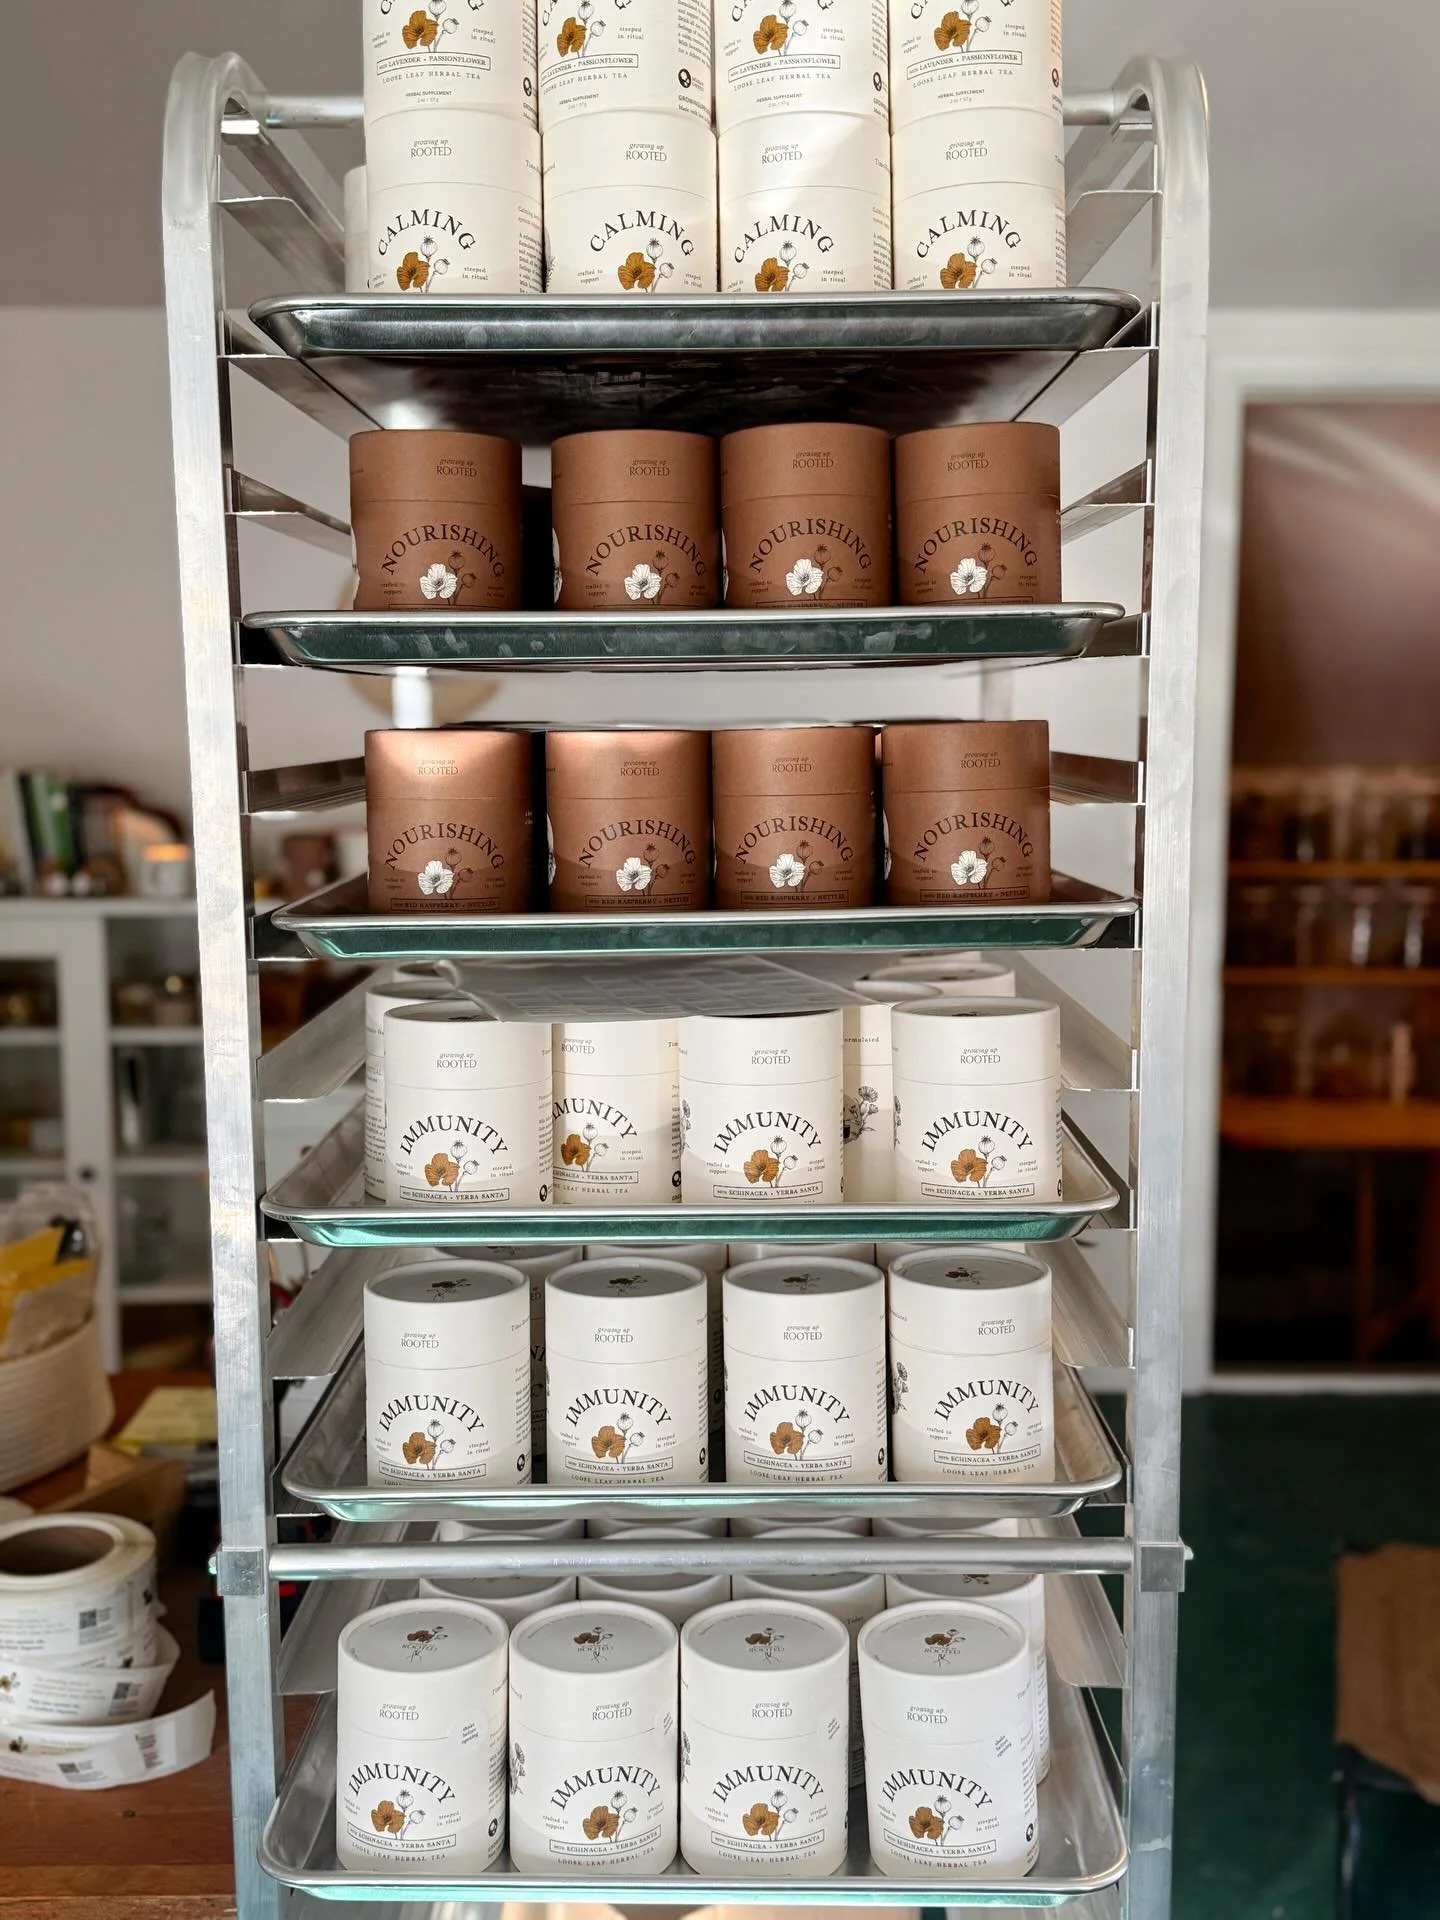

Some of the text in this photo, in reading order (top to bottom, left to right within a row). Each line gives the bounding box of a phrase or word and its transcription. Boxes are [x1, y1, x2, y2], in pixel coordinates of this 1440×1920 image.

[429, 56, 486, 65] PASSIONFLOWER
[578, 58, 633, 67] PASSIONFLOWER
[920, 57, 953, 70] LAVENDER
[382, 74, 402, 84] LOOSE
[734, 81, 753, 92] LOOSE
[757, 76, 775, 84] LEAF
[913, 78, 934, 88] LOOSE
[938, 72, 956, 81] LEAF
[411, 147, 452, 158] ROOTED
[626, 150, 667, 161] ROOTED
[761, 151, 803, 165] ROOTED
[946, 147, 987, 161] ROOTED
[378, 209, 476, 256] CALMING
[590, 210, 694, 256] CALMING
[735, 214, 835, 263] CALMING
[917, 210, 1022, 258] CALMING
[792, 458, 833, 469] ROOTED
[948, 459, 988, 472] ROOTED
[436, 466, 477, 478] ROOTED
[630, 466, 670, 477] ROOTED
[382, 524, 505, 579] NOURISHING
[586, 524, 706, 577] NOURISHING
[749, 518, 871, 573] NOURISHING
[915, 518, 1037, 574] NOURISHING
[772, 764, 812, 773] ROOTED
[960, 759, 1001, 768] ROOTED
[418, 766, 458, 775] ROOTED
[620, 768, 659, 777] ROOTED
[736, 816, 853, 865] NOURISHING
[914, 812, 1033, 862] NOURISHING
[385, 823, 504, 870] NOURISHING
[579, 820, 696, 868] NOURISHING
[562, 1044, 595, 1054] ROOTED
[437, 1059, 477, 1068] ROOTED
[752, 1055, 791, 1065] ROOTED
[960, 1055, 1001, 1064] ROOTED
[400, 1115, 508, 1156] IMMUNITY
[714, 1112, 822, 1154] IMMUNITY
[922, 1110, 1033, 1152] IMMUNITY
[936, 1188, 976, 1196] ECHINACEA
[978, 1325, 1015, 1335] ROOTED
[594, 1334, 633, 1343] ROOTED
[783, 1332, 822, 1341] ROOTED
[401, 1339, 439, 1349] ROOTED
[744, 1385, 849, 1423] IMMUNITY
[934, 1380, 1038, 1421] IMMUNITY
[379, 1395, 484, 1432] IMMUNITY
[566, 1389, 671, 1427] IMMUNITY
[757, 1458, 793, 1468] ECHINACEA
[998, 1453, 1019, 1461] YERBA
[458, 1468, 481, 1476] SANTA
[578, 1462, 614, 1471] ECHINACEA
[943, 1468, 965, 1476] LOOSE
[380, 1709, 419, 1721] ROOTED
[592, 1708, 632, 1720] ROOTED
[752, 1708, 792, 1718] ROOTED
[907, 1712, 947, 1723] ROOTED
[349, 1763, 455, 1803] IMMUNITY
[551, 1766, 661, 1810] IMMUNITY
[713, 1765, 824, 1803] IMMUNITY
[882, 1769, 992, 1808] IMMUNITY
[359, 1831, 392, 1847] ECHINACEA
[427, 1839, 450, 1847] SANTA
[616, 1841, 637, 1849] YERBA
[639, 1831, 658, 1844] SANTA
[727, 1840, 766, 1849] ECHINACEA
[800, 1835, 820, 1844] SANTA
[968, 1845, 991, 1853] SANTA
[719, 1851, 740, 1861] LOOSE
